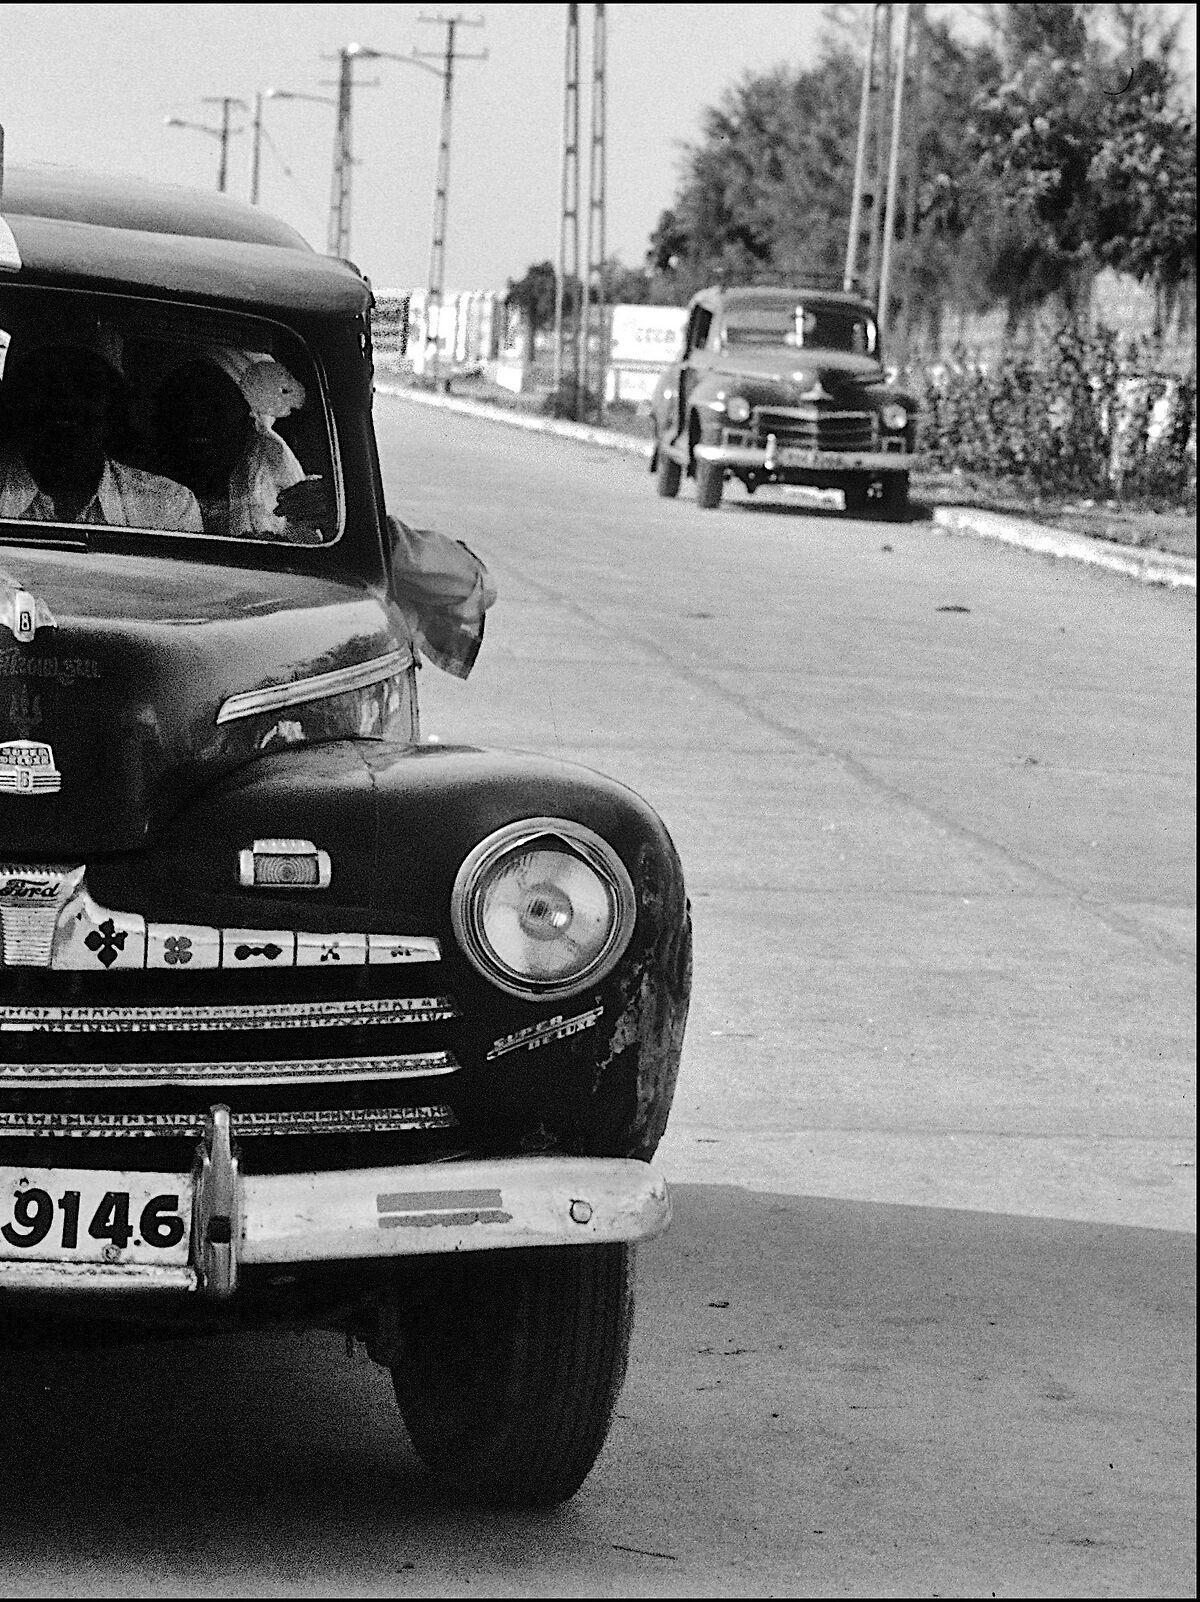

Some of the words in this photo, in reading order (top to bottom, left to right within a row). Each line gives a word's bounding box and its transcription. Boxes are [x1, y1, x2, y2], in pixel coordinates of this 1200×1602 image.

[21, 612, 31, 631] 8
[493, 1015, 563, 1051] SUPER
[1, 1187, 185, 1249] 9146
